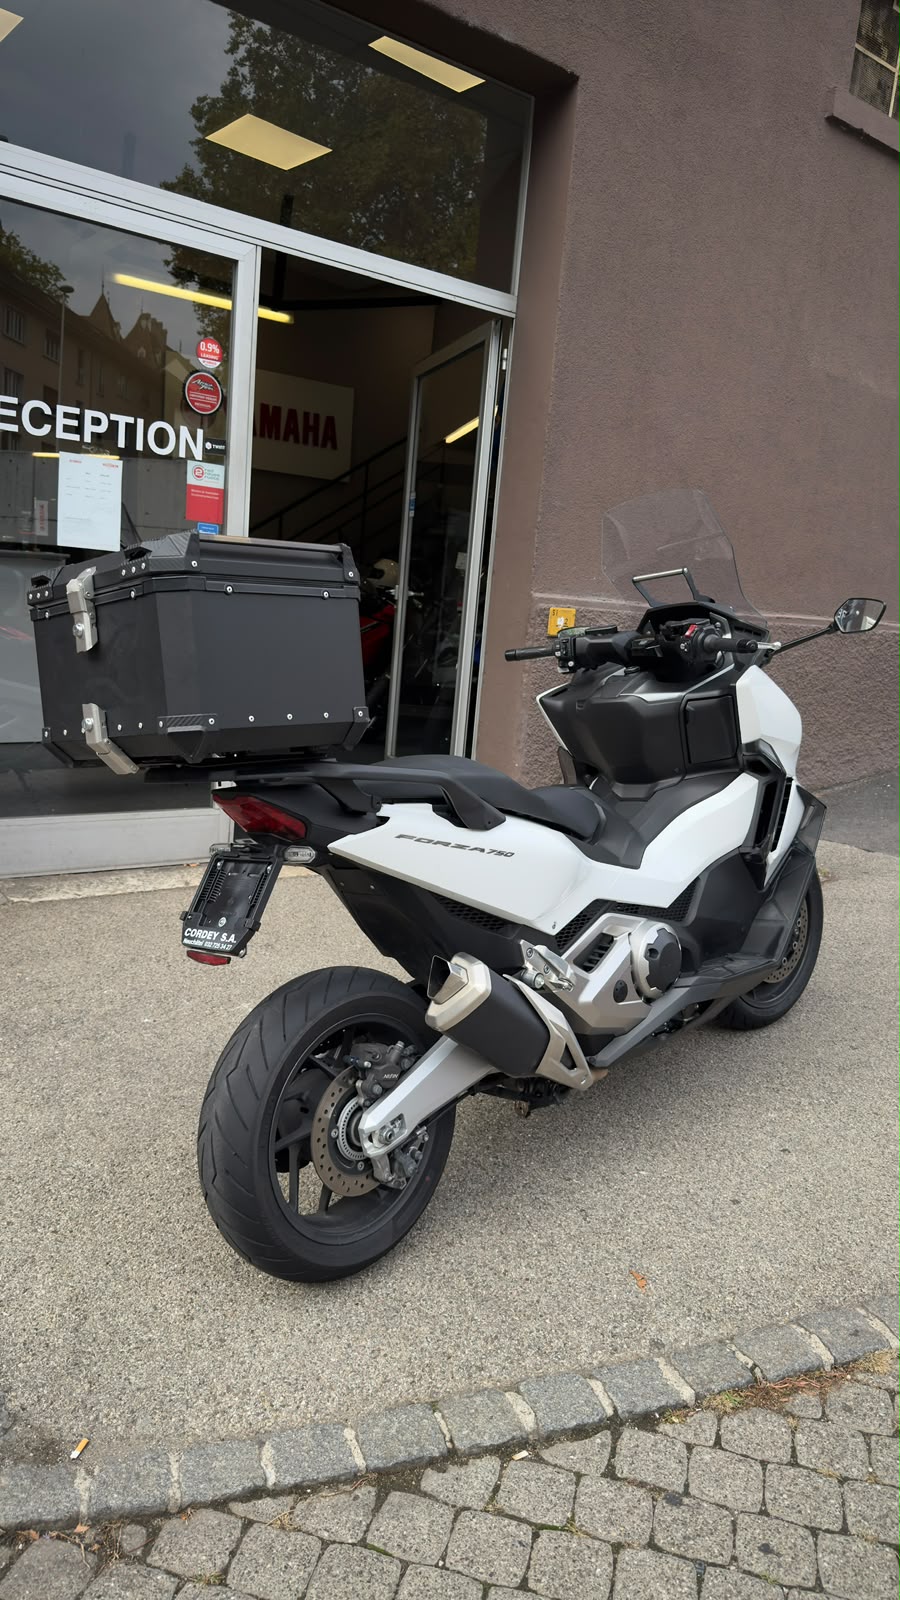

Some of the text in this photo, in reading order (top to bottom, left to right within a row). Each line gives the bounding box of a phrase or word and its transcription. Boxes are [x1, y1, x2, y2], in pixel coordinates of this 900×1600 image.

[200, 341, 220, 354] 0.9%
[0, 395, 204, 460] ECEPTION
[252, 402, 338, 450] MAHA
[184, 928, 236, 943] CORDEY S.A.
